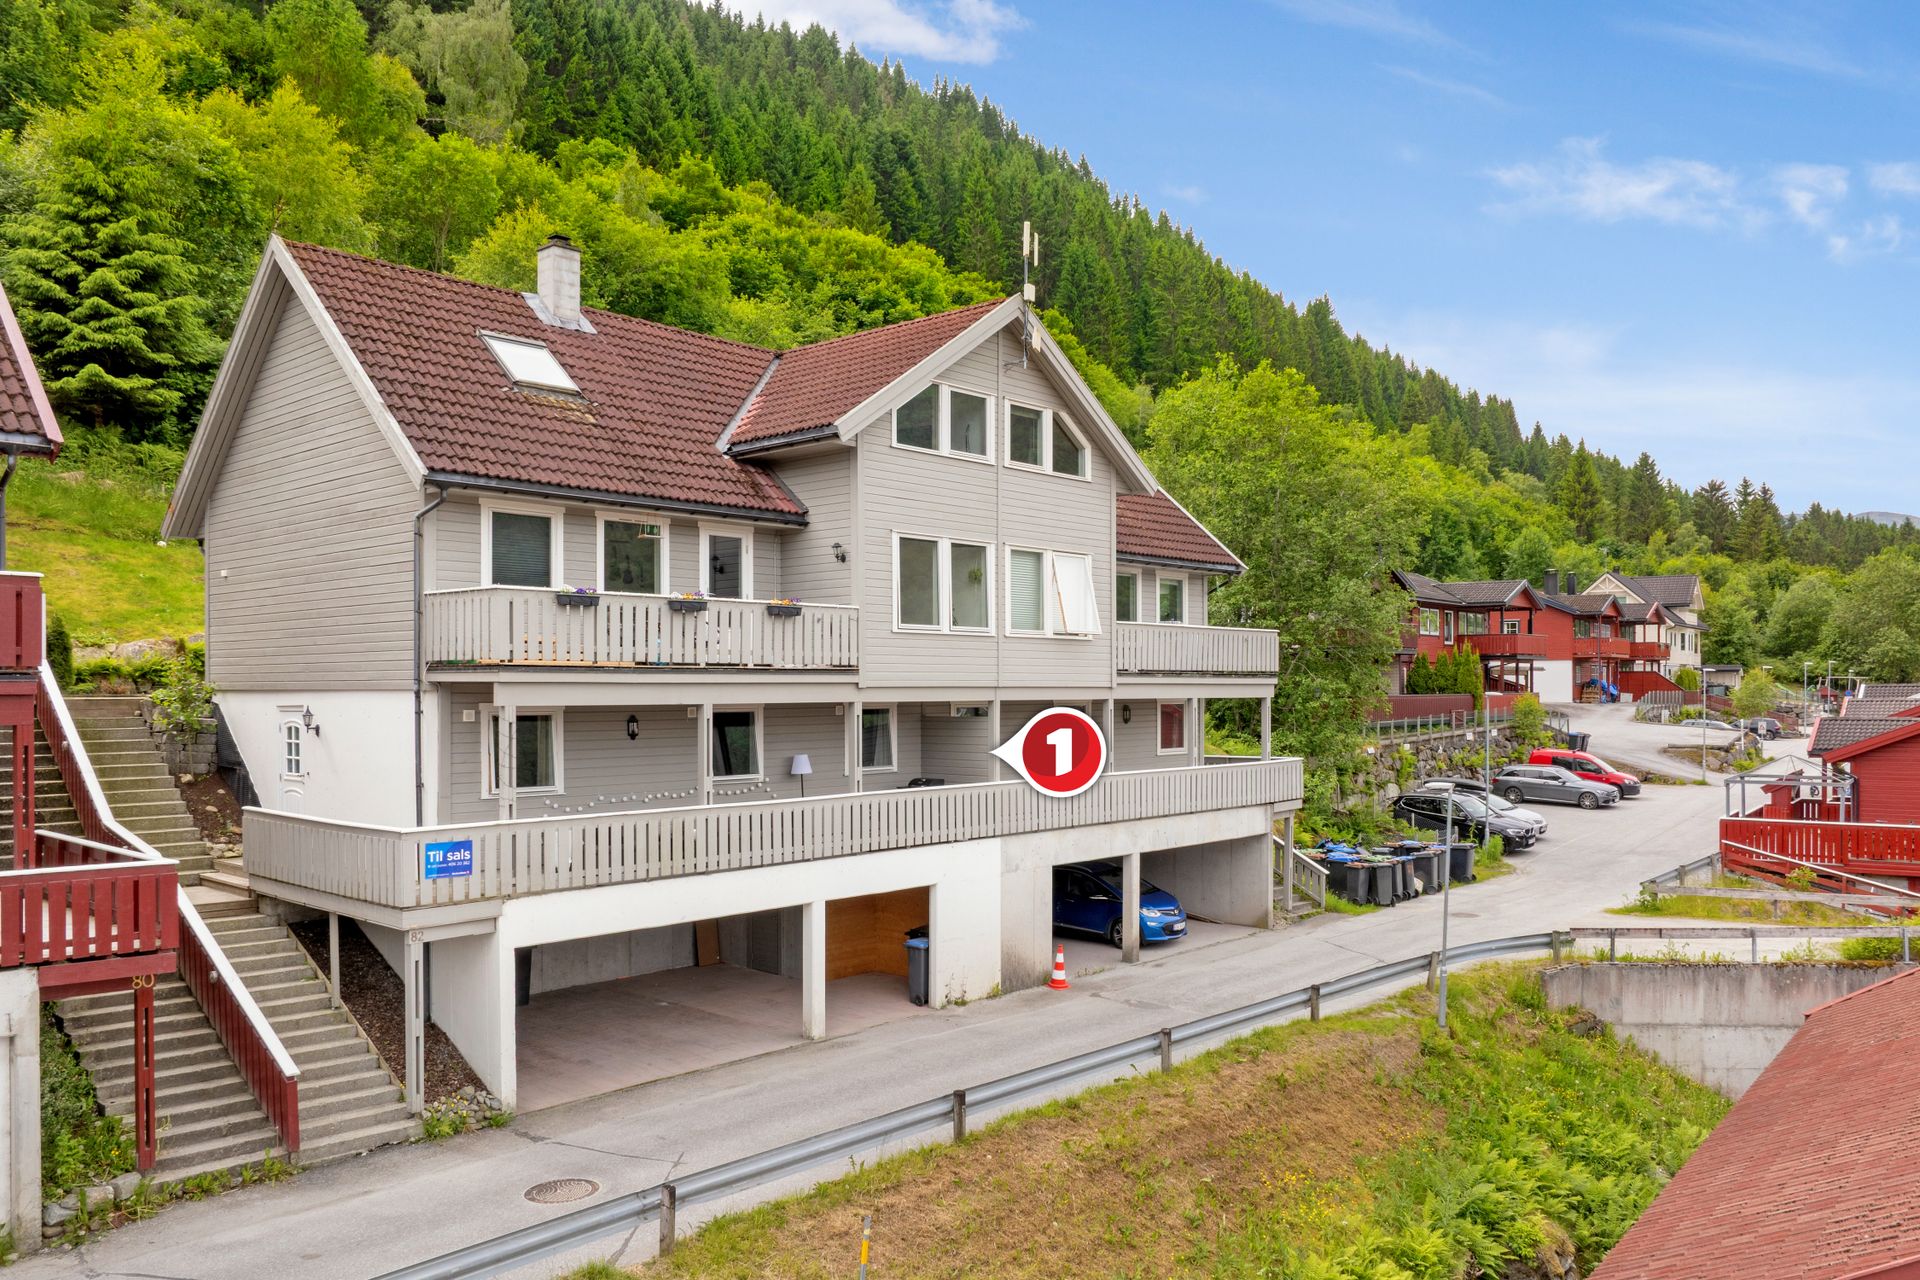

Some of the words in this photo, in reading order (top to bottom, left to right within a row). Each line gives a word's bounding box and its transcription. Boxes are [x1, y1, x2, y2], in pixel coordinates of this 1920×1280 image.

[427, 850, 443, 862] Til
[447, 848, 471, 861] sals
[411, 931, 424, 942] 82
[132, 973, 155, 989] 80
